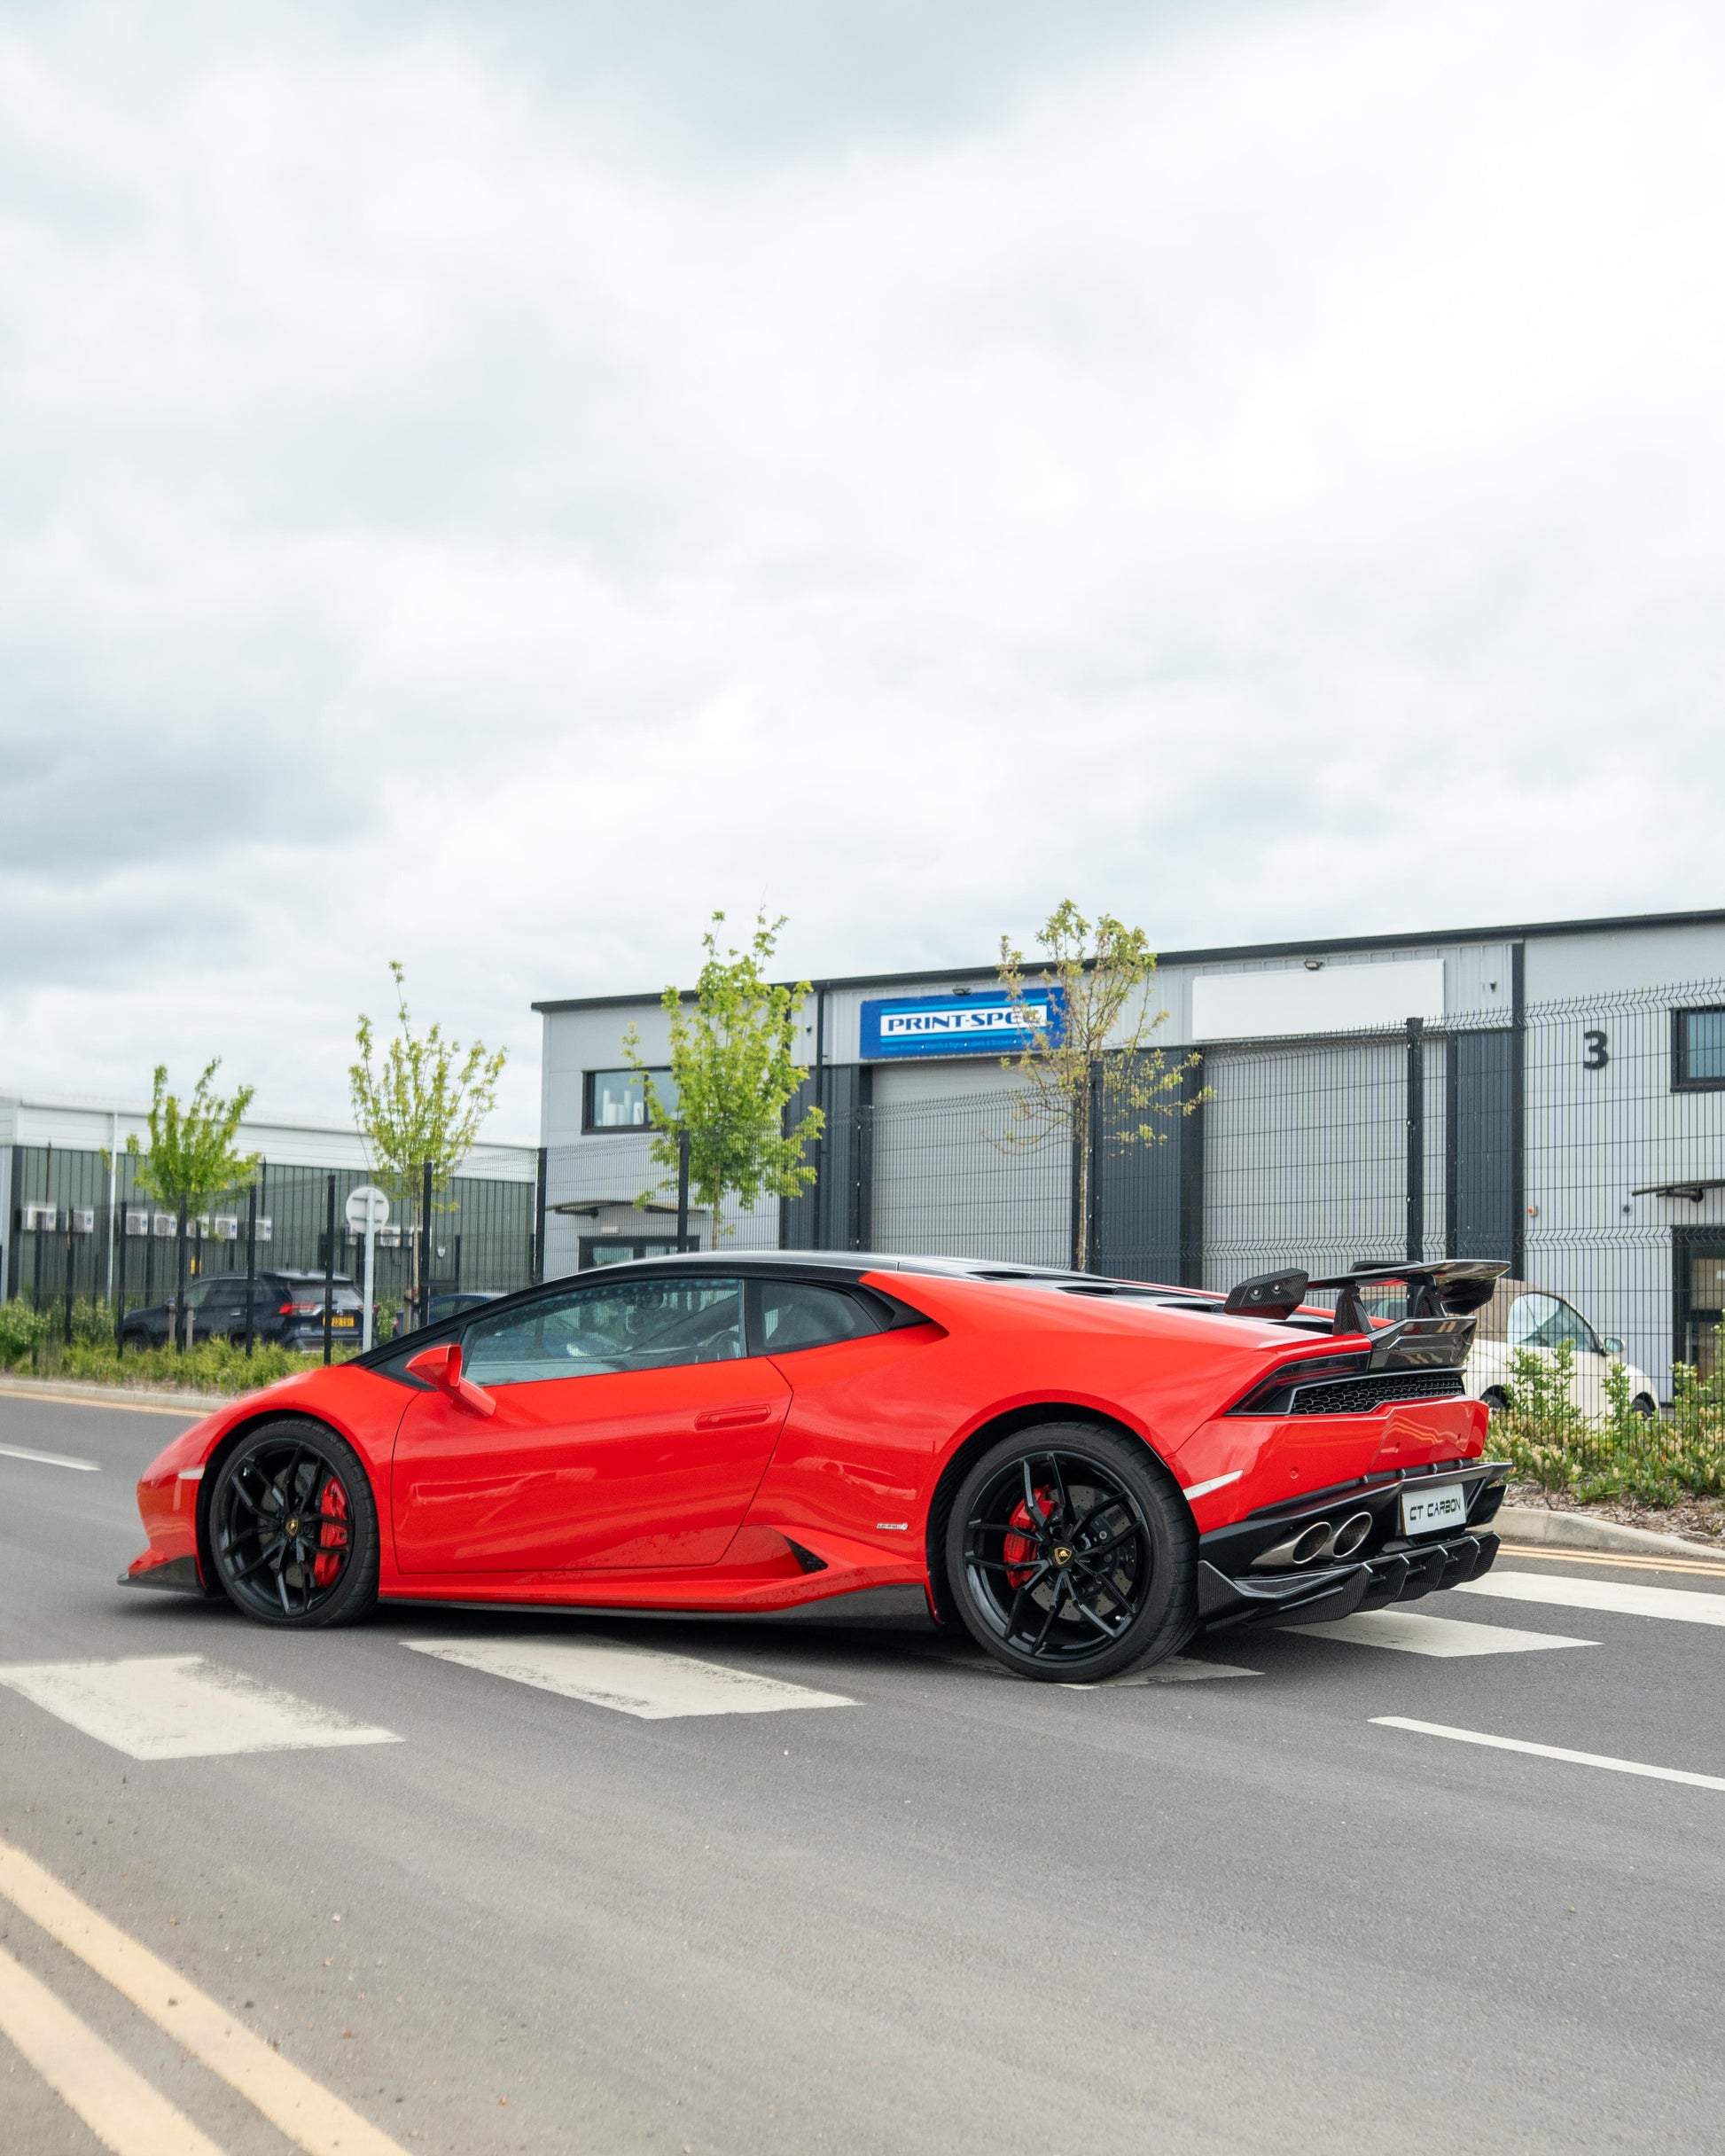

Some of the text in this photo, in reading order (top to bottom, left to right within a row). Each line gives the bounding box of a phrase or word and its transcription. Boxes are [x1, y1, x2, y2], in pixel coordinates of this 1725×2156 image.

[1583, 1030, 1609, 1070] 3
[1409, 1497, 1461, 1520] CT CARBON
